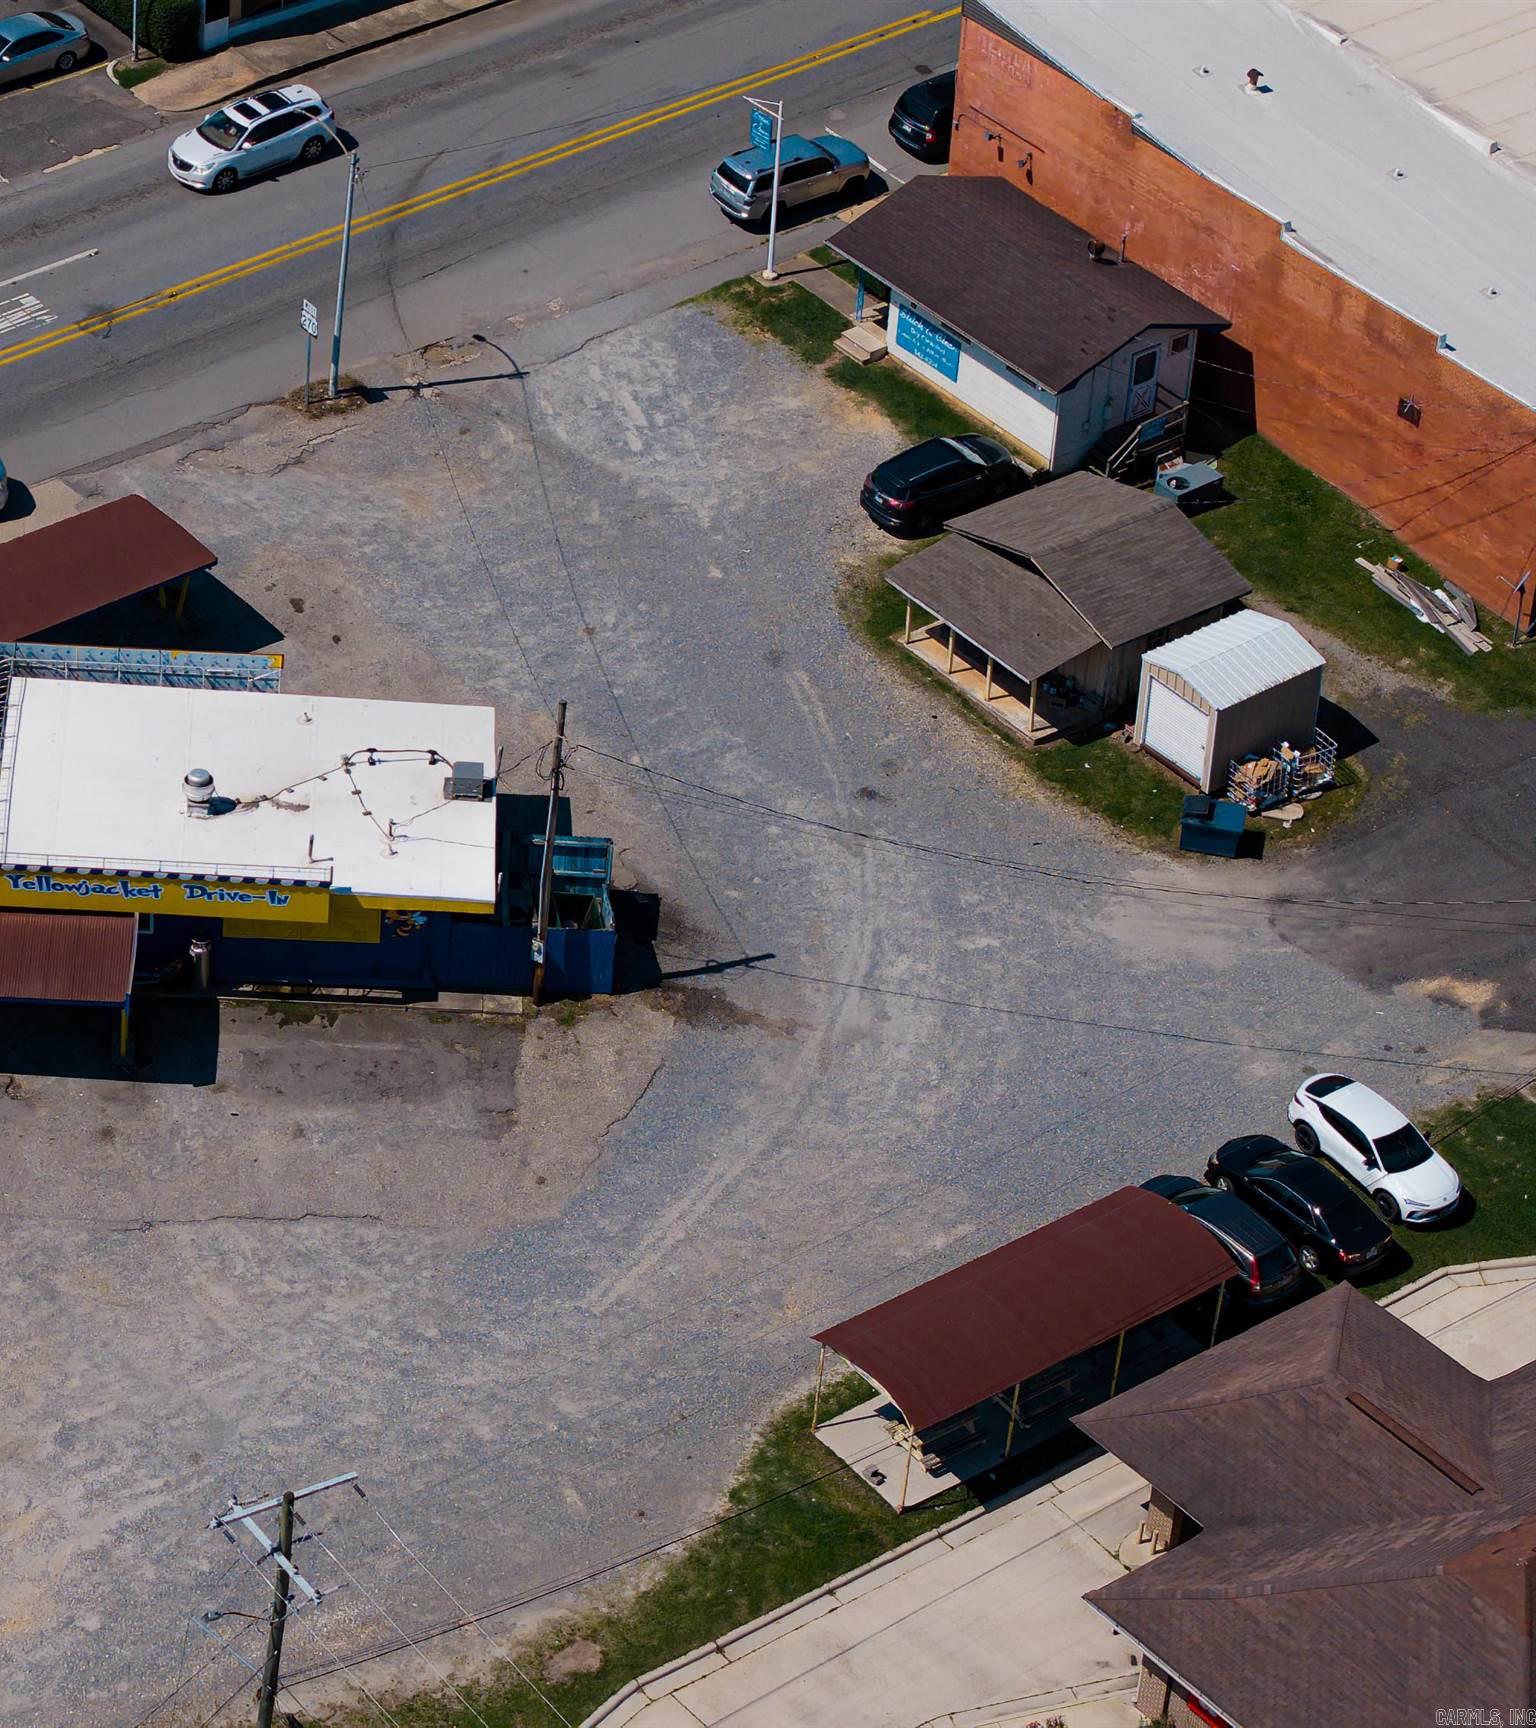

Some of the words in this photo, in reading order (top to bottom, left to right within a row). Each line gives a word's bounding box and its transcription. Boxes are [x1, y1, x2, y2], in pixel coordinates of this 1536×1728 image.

[302, 314, 317, 334] 270
[6, 873, 163, 899] Yellowjacket
[182, 883, 289, 907] Drive-In
